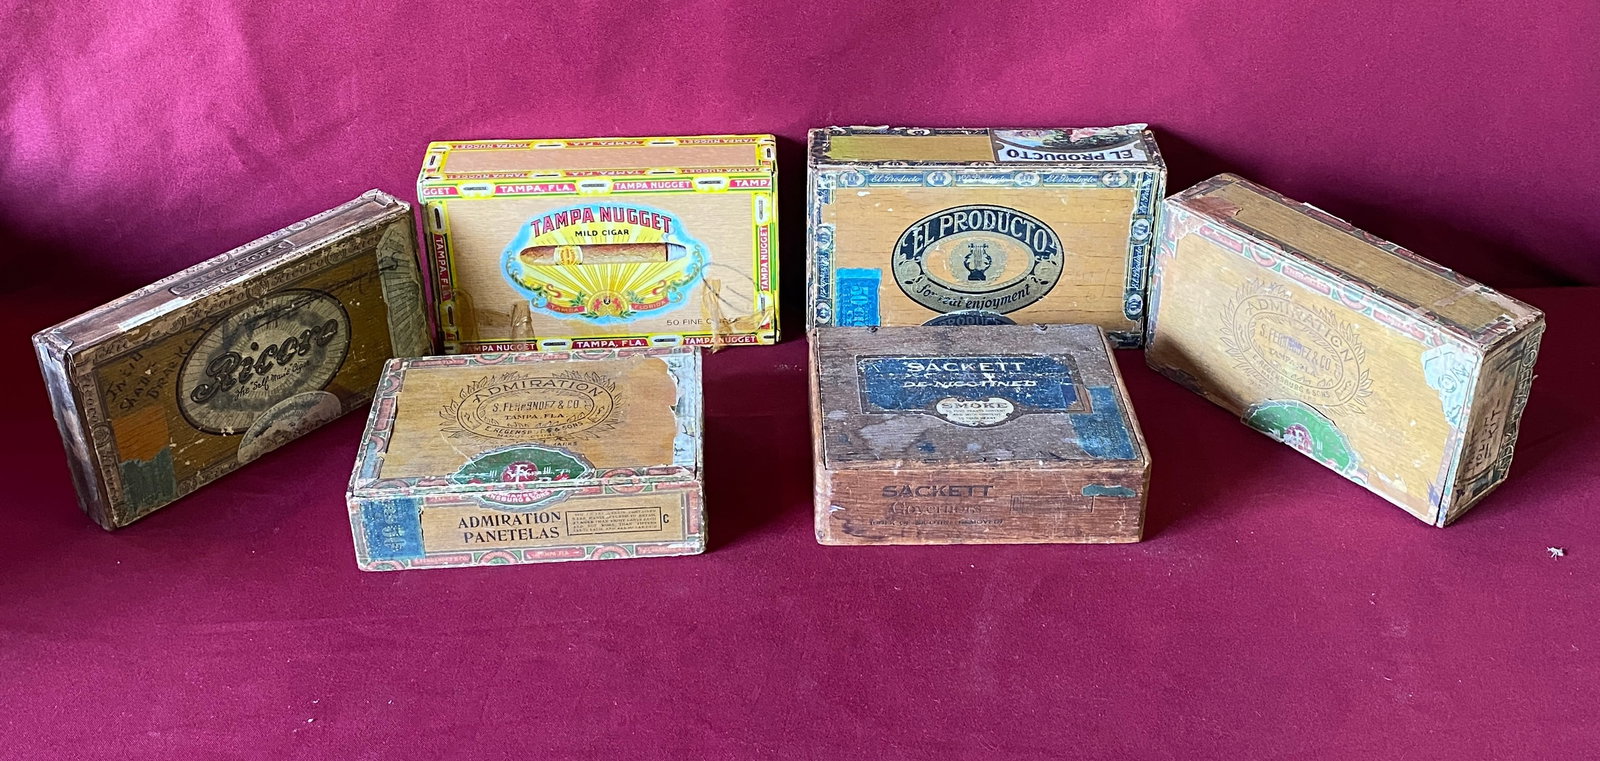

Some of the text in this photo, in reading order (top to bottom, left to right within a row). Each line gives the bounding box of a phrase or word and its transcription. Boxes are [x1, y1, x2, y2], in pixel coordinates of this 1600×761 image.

[1006, 149, 1134, 162] EL PRODUCTO
[871, 172, 922, 183] El Producto
[548, 184, 573, 192] FLA.
[615, 180, 690, 190] TAMPA NUGGET
[423, 187, 450, 196] GGET
[531, 206, 672, 238] TAMPA NUGGET
[912, 210, 1049, 256] EL PRODUCTO
[760, 226, 770, 291] TAMPA NUGGET
[917, 280, 937, 299] for
[966, 283, 1031, 311] enjoyment
[550, 304, 579, 312] TAMPA
[634, 300, 666, 310] FLORIDA
[622, 339, 646, 348] FLA.
[719, 336, 756, 344] NUGGET
[496, 344, 535, 352] NUGGET
[190, 318, 339, 404] Ricoro
[906, 362, 1026, 372] SACKETT
[902, 380, 1038, 389] DE-NICOTINED
[235, 387, 250, 400] The
[472, 378, 604, 404] ADMIRATION
[558, 400, 564, 410] &
[562, 421, 584, 430] SONS
[882, 485, 994, 498] SACKETT
[458, 510, 561, 529] ADMIRATION
[662, 514, 670, 524] C
[463, 526, 560, 544] PANETELAS
